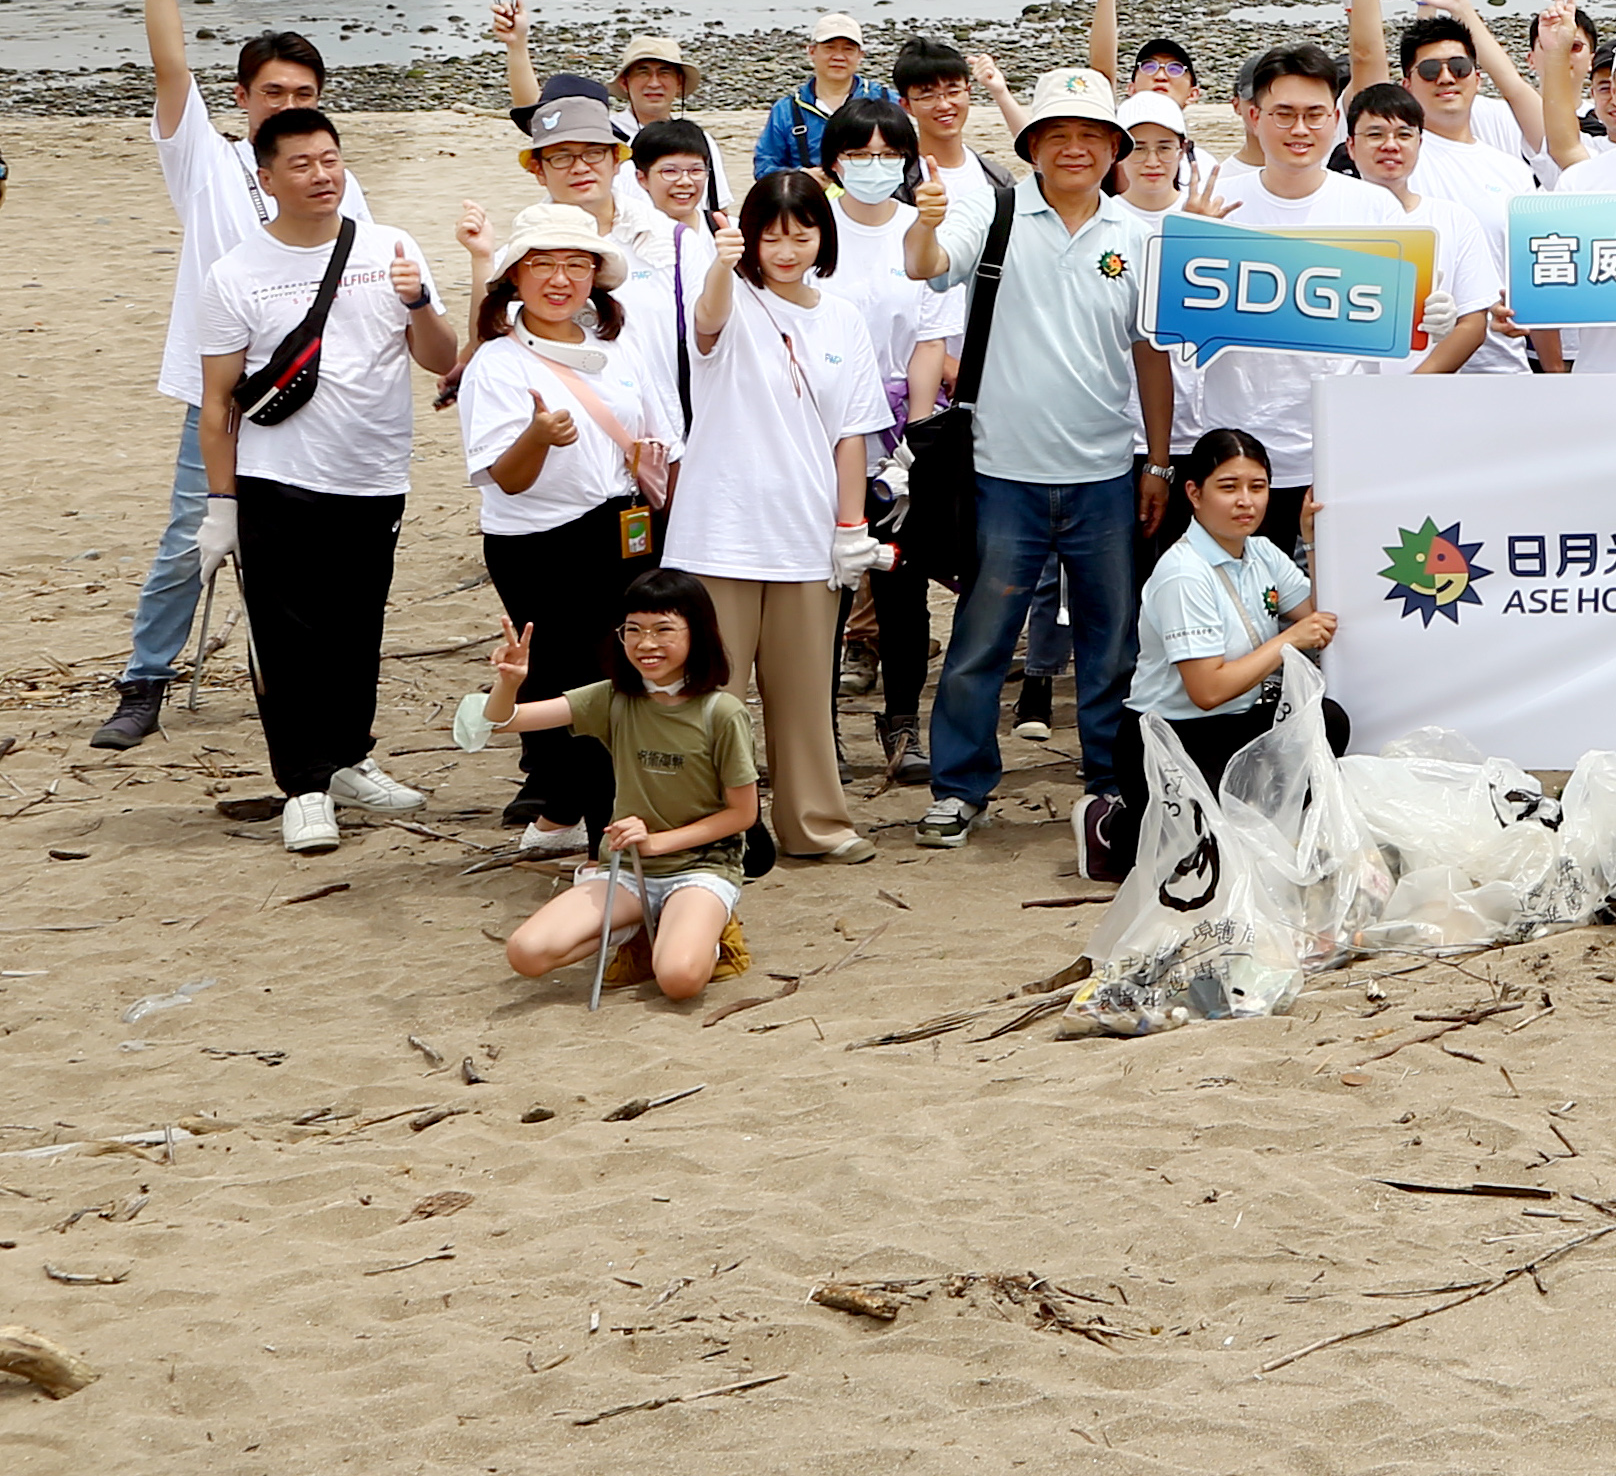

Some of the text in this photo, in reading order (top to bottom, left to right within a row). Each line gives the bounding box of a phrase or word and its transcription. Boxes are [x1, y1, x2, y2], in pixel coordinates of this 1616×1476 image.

[337, 270, 386, 288] ILFIGER
[1183, 257, 1383, 323] SDGs
[1502, 586, 1569, 615] ASE
